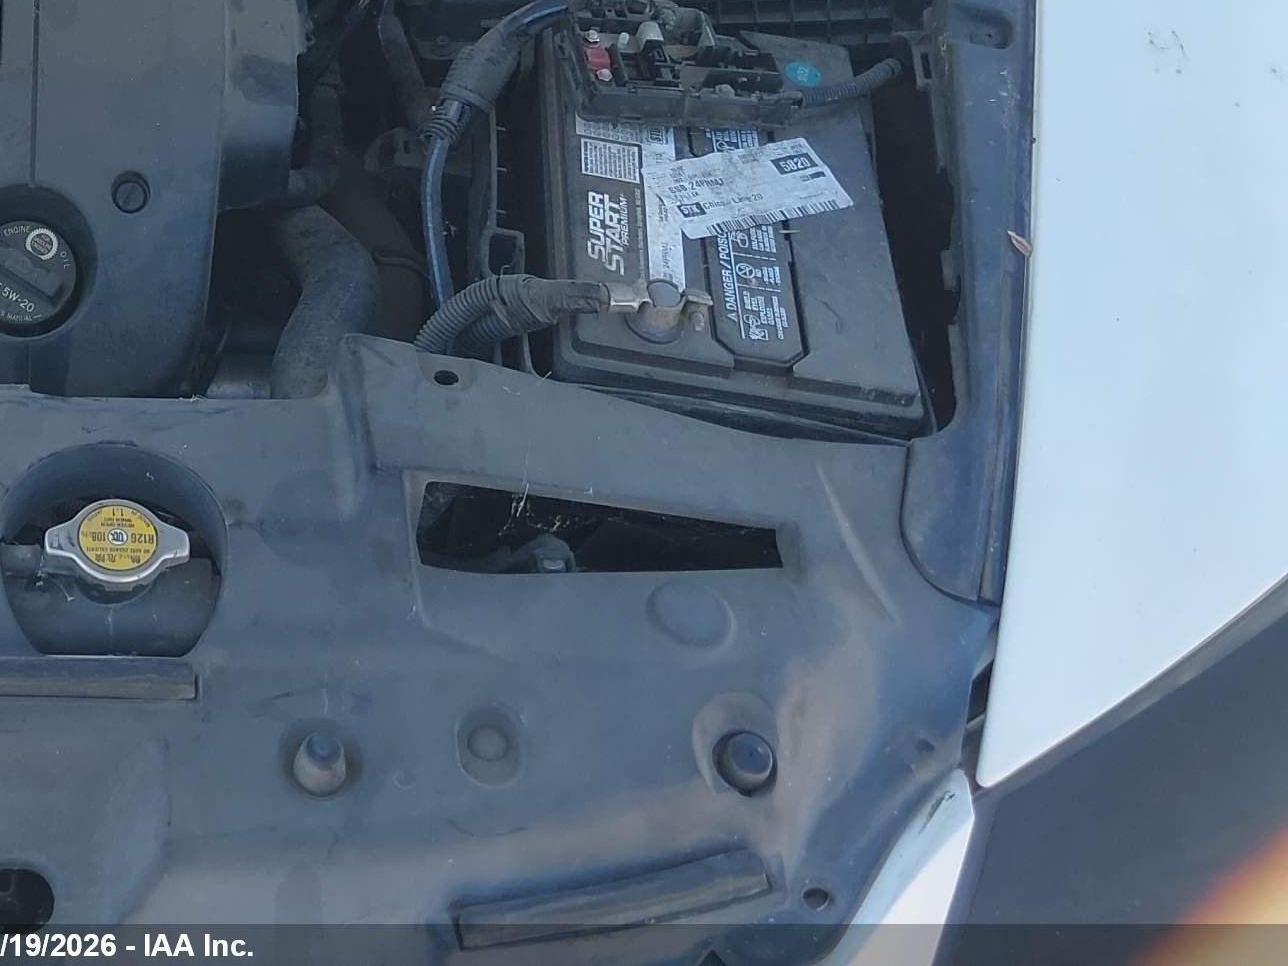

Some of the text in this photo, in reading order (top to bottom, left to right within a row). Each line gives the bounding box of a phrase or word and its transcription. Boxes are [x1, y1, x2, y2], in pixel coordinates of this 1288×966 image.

[778, 156, 812, 172] 5820
[3, 225, 72, 270] ENGINE OIL
[587, 191, 606, 263] SUPER
[603, 193, 625, 276] START
[2, 286, 35, 312] 5W-20
[722, 270, 738, 311] DANGER
